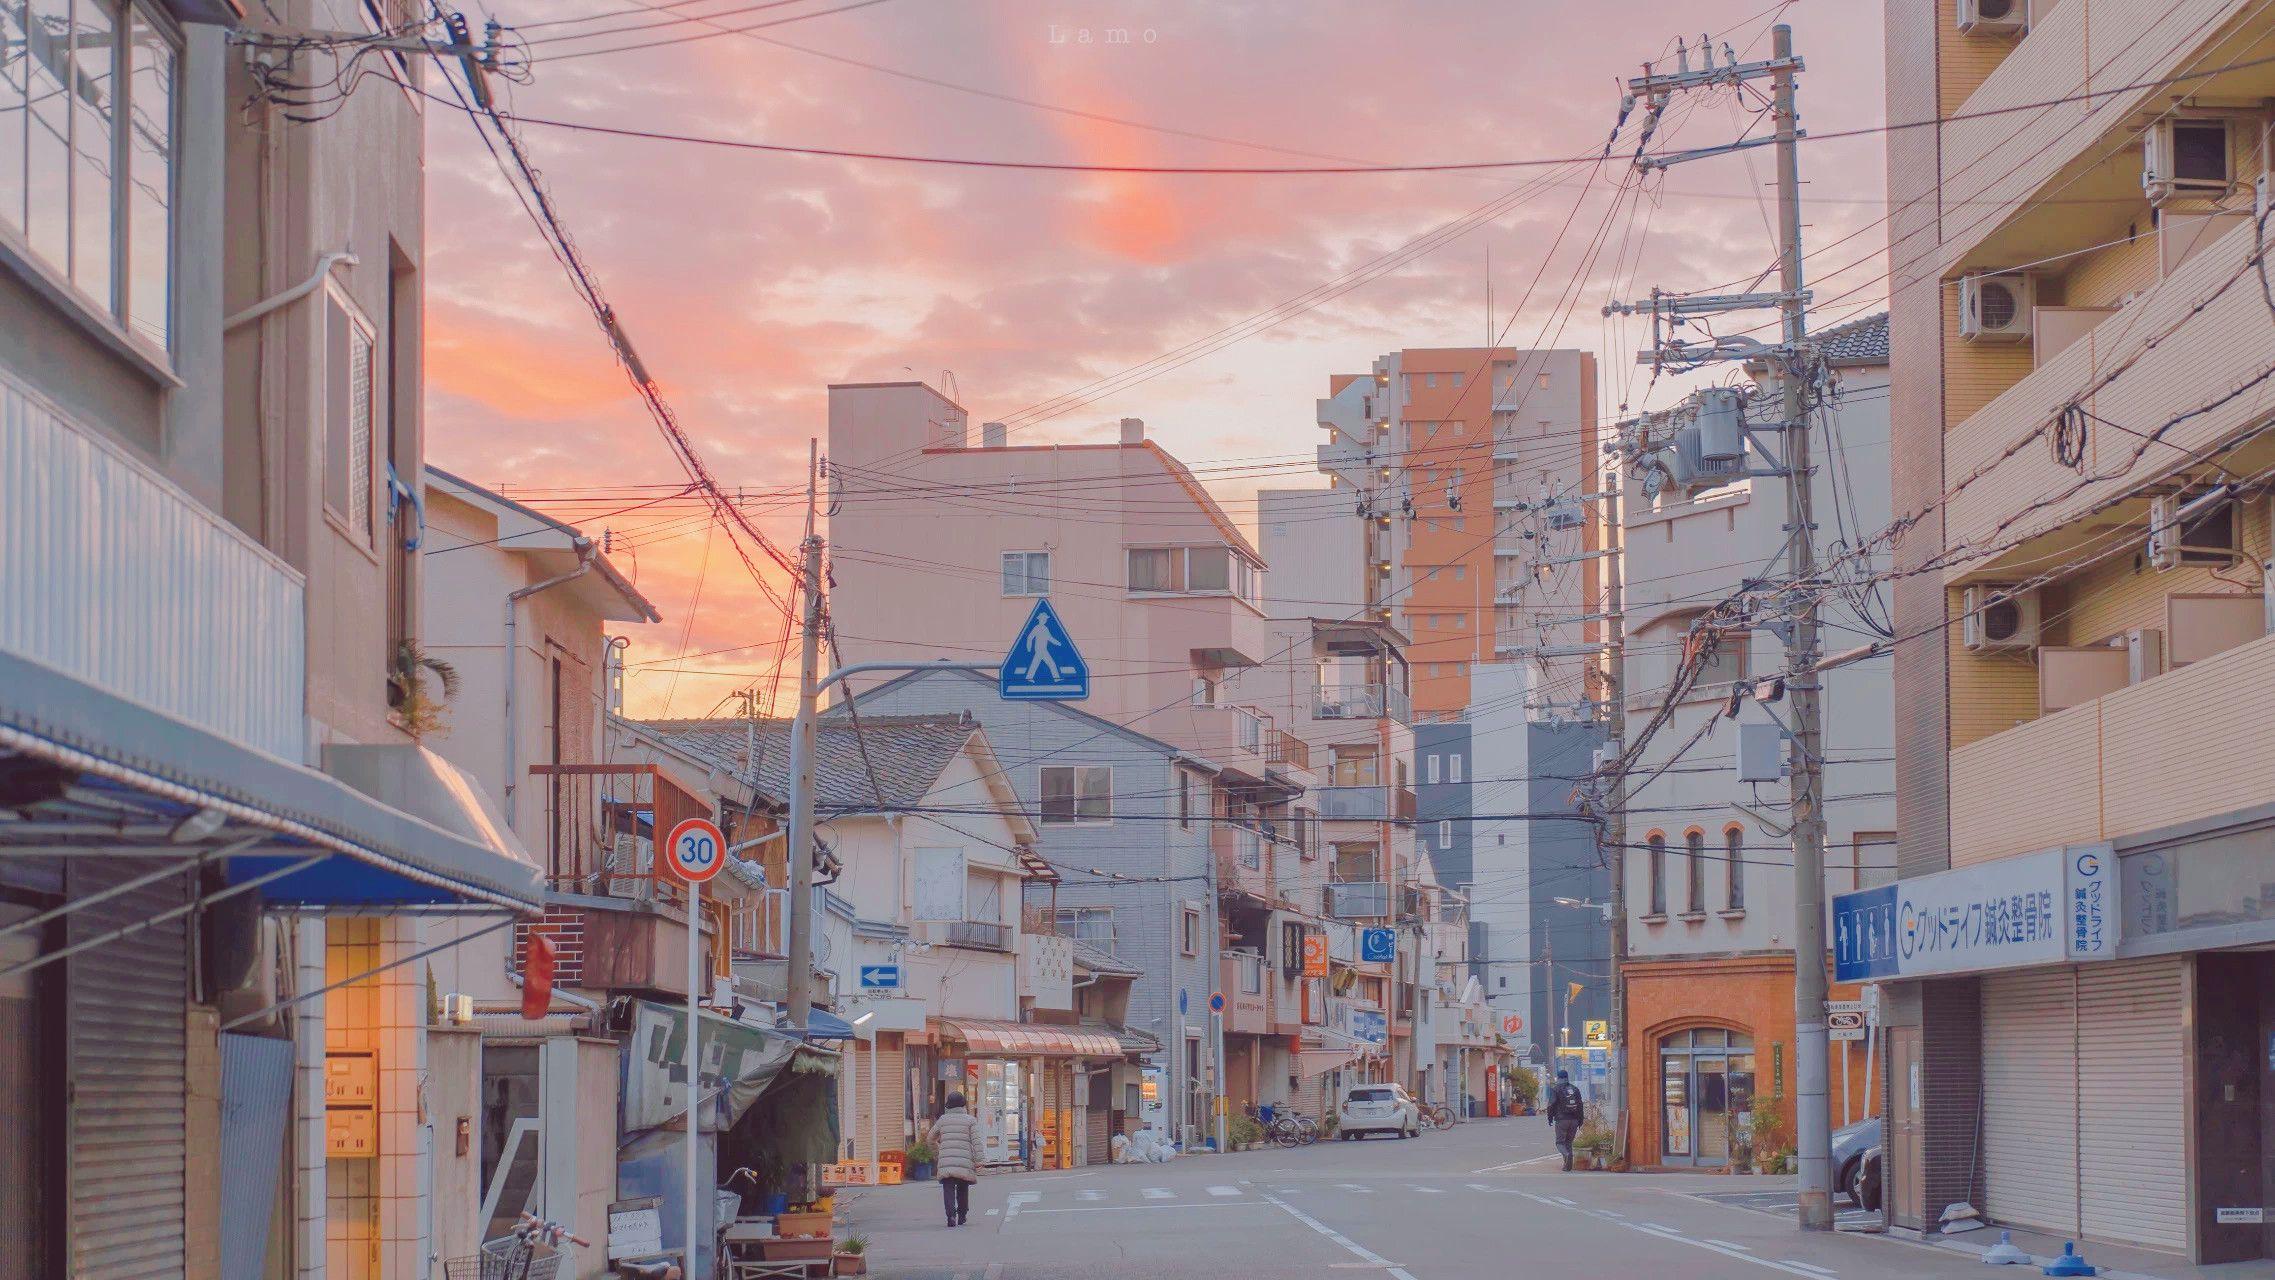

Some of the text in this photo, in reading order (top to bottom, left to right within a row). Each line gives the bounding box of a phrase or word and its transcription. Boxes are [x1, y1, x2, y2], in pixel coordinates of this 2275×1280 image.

[681, 836, 713, 864] 30
[2089, 880, 2103, 952] グッドライフ
